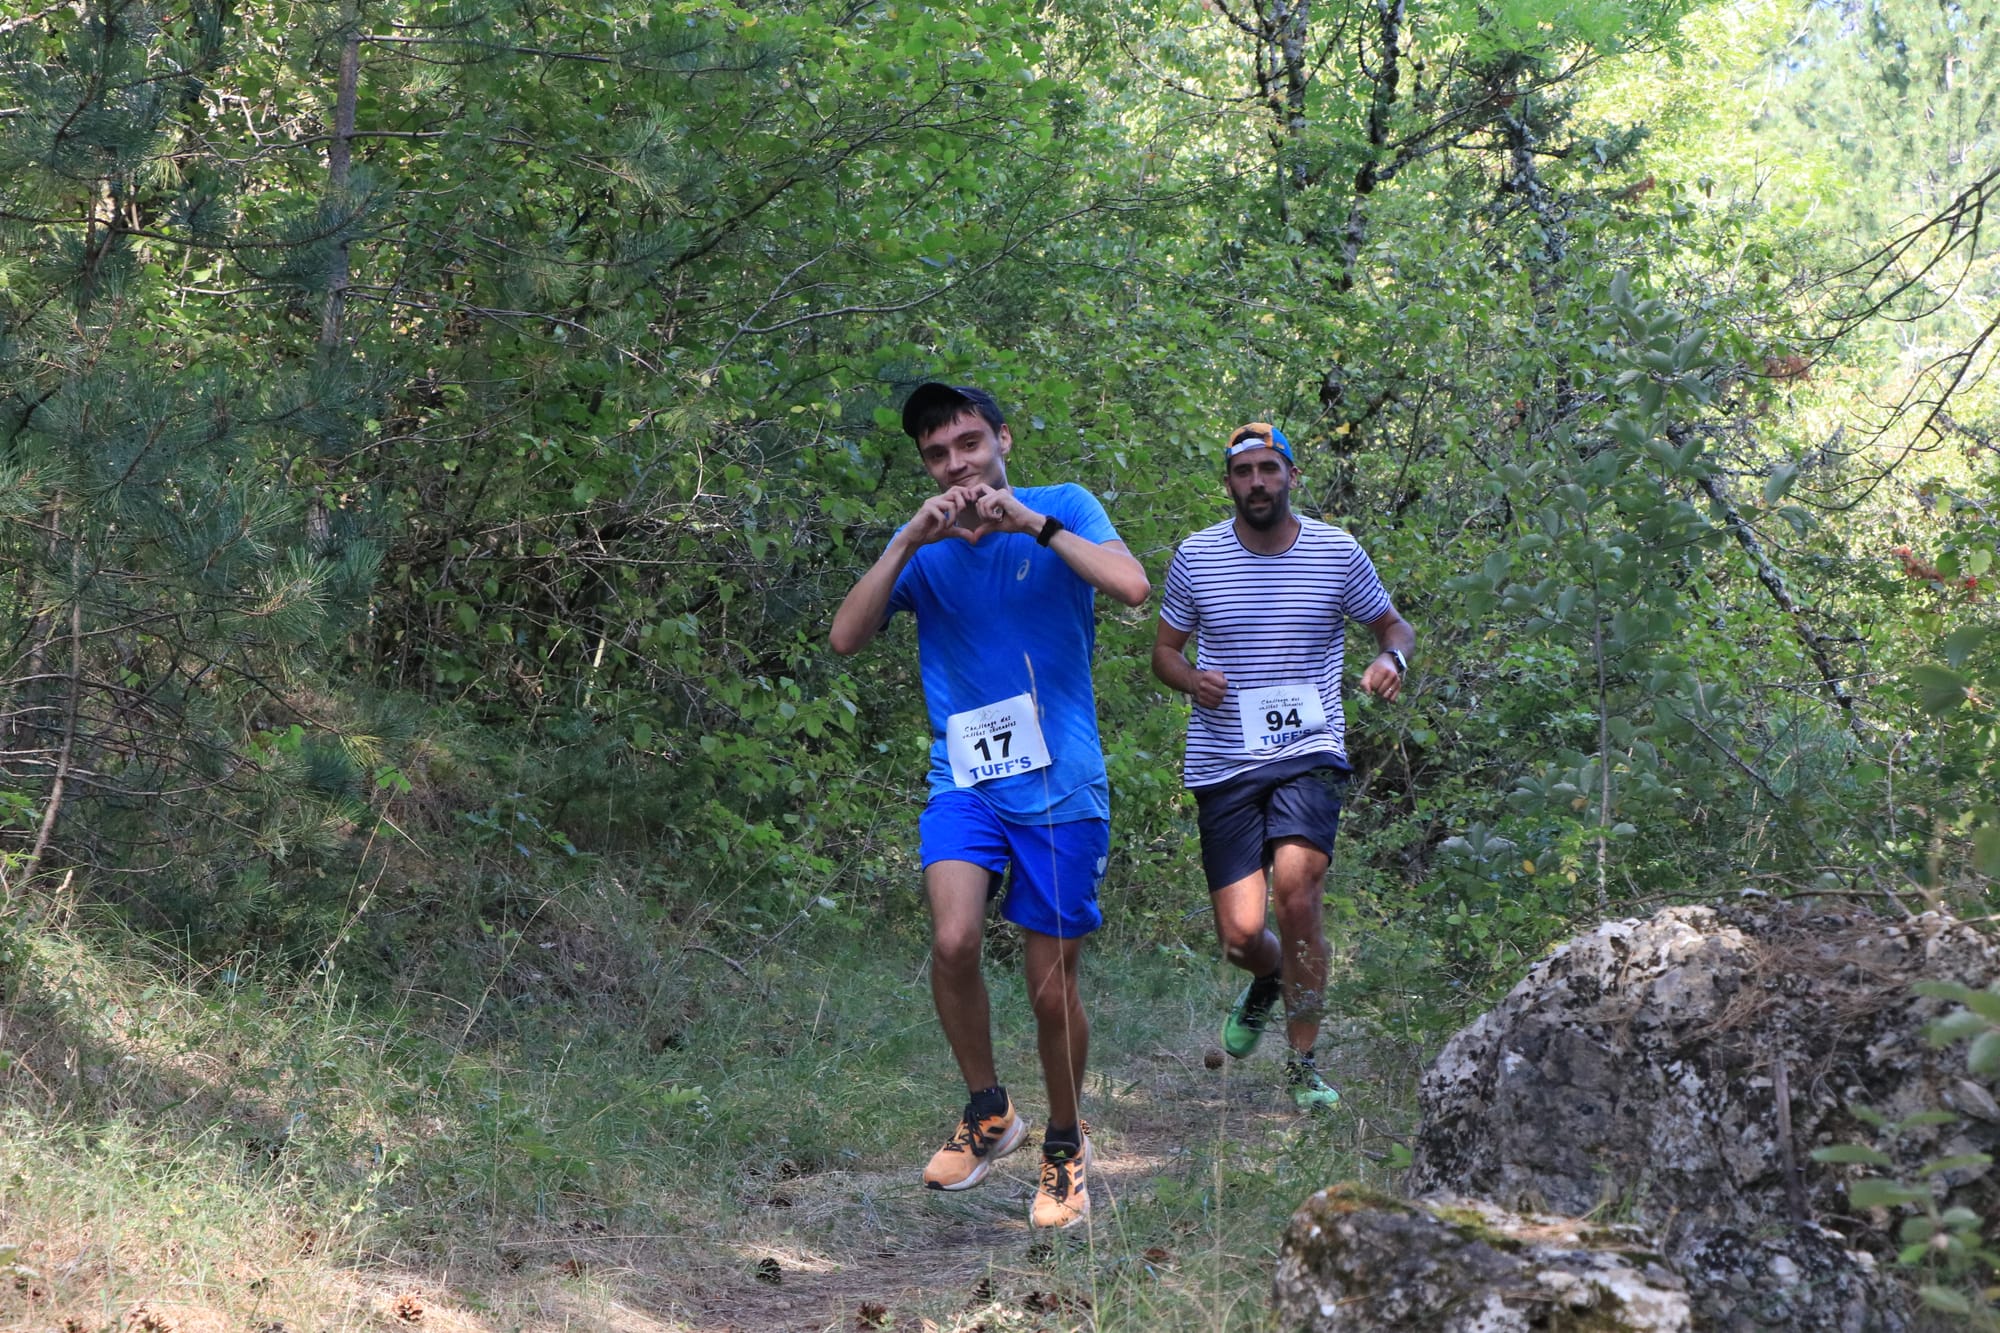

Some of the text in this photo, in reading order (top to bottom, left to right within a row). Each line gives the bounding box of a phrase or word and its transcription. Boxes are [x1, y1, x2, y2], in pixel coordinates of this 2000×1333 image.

[1266, 708, 1302, 732] 94
[974, 730, 1012, 761] 17
[969, 756, 1032, 780] TUFF'S
